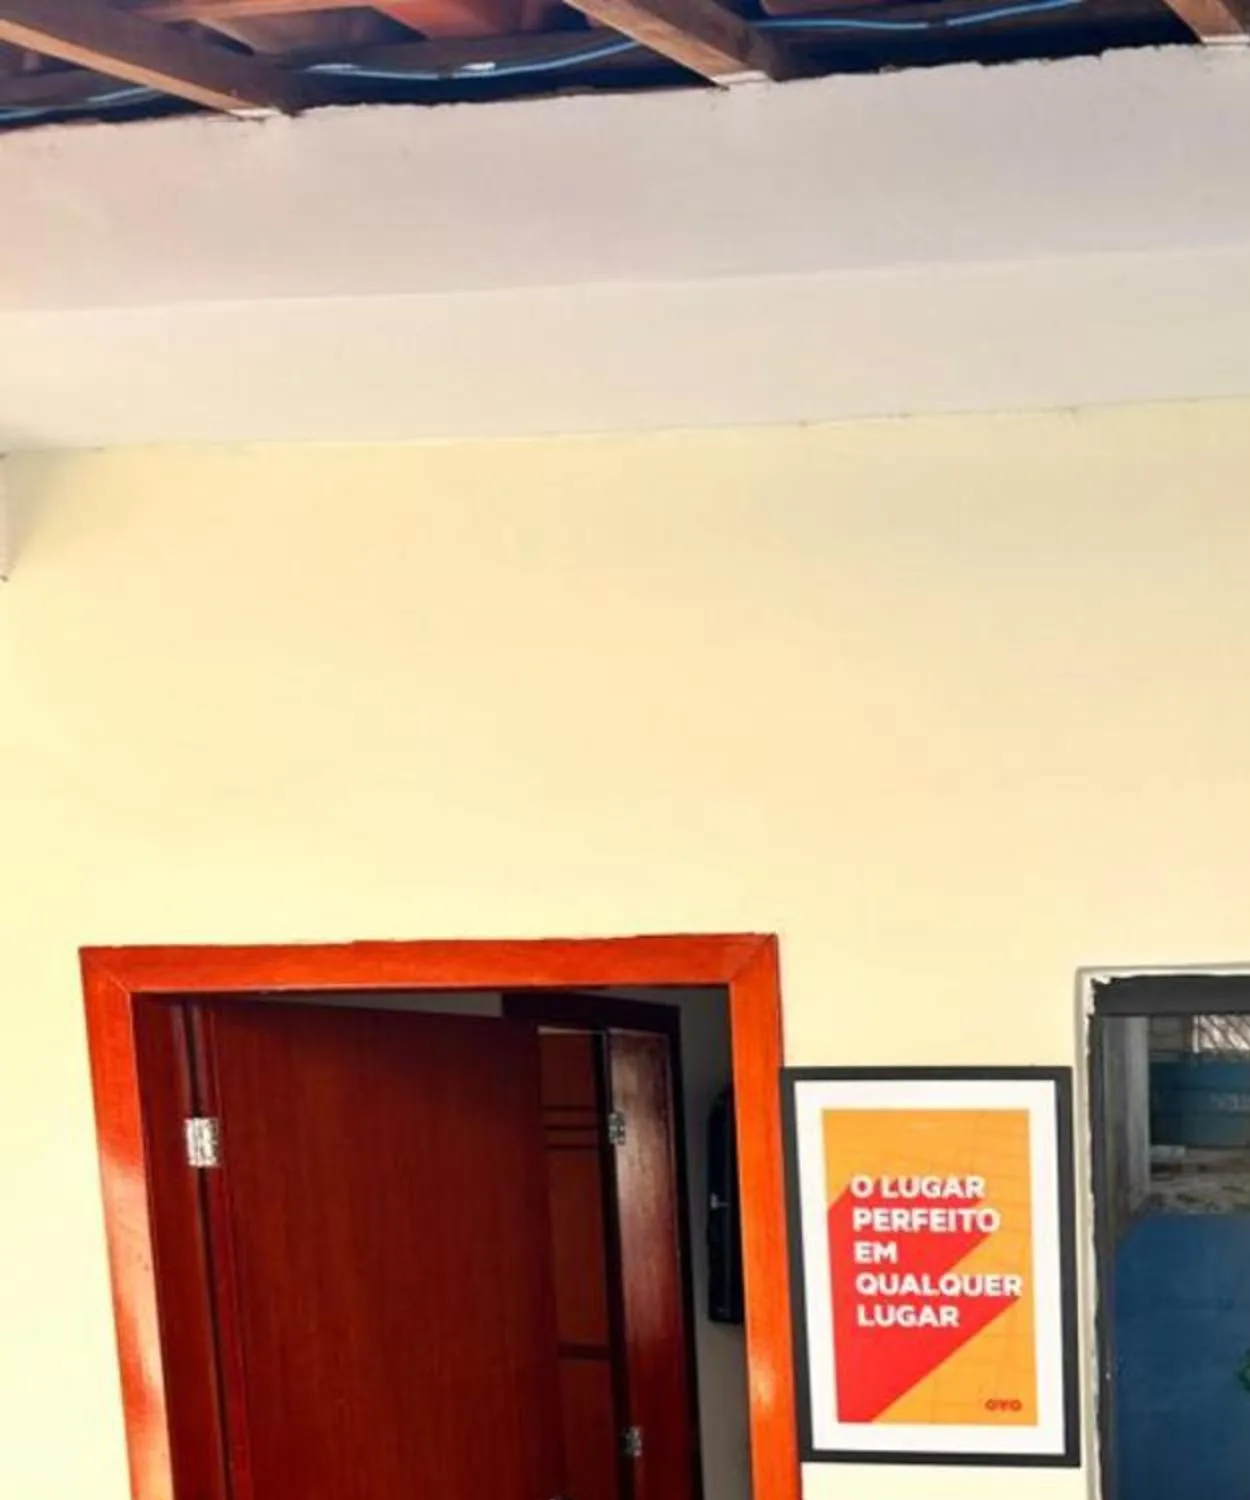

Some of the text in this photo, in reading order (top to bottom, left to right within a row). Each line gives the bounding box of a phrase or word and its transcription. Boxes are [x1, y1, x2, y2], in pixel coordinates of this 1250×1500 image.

[851, 1175, 986, 1199] O LUGAR
[852, 1207, 1002, 1233] PERFEITO
[853, 1240, 898, 1264] EM
[855, 1272, 1024, 1298] QUALQUER
[857, 1304, 960, 1327] LUGAR
[984, 1398, 1023, 1412] OYO
